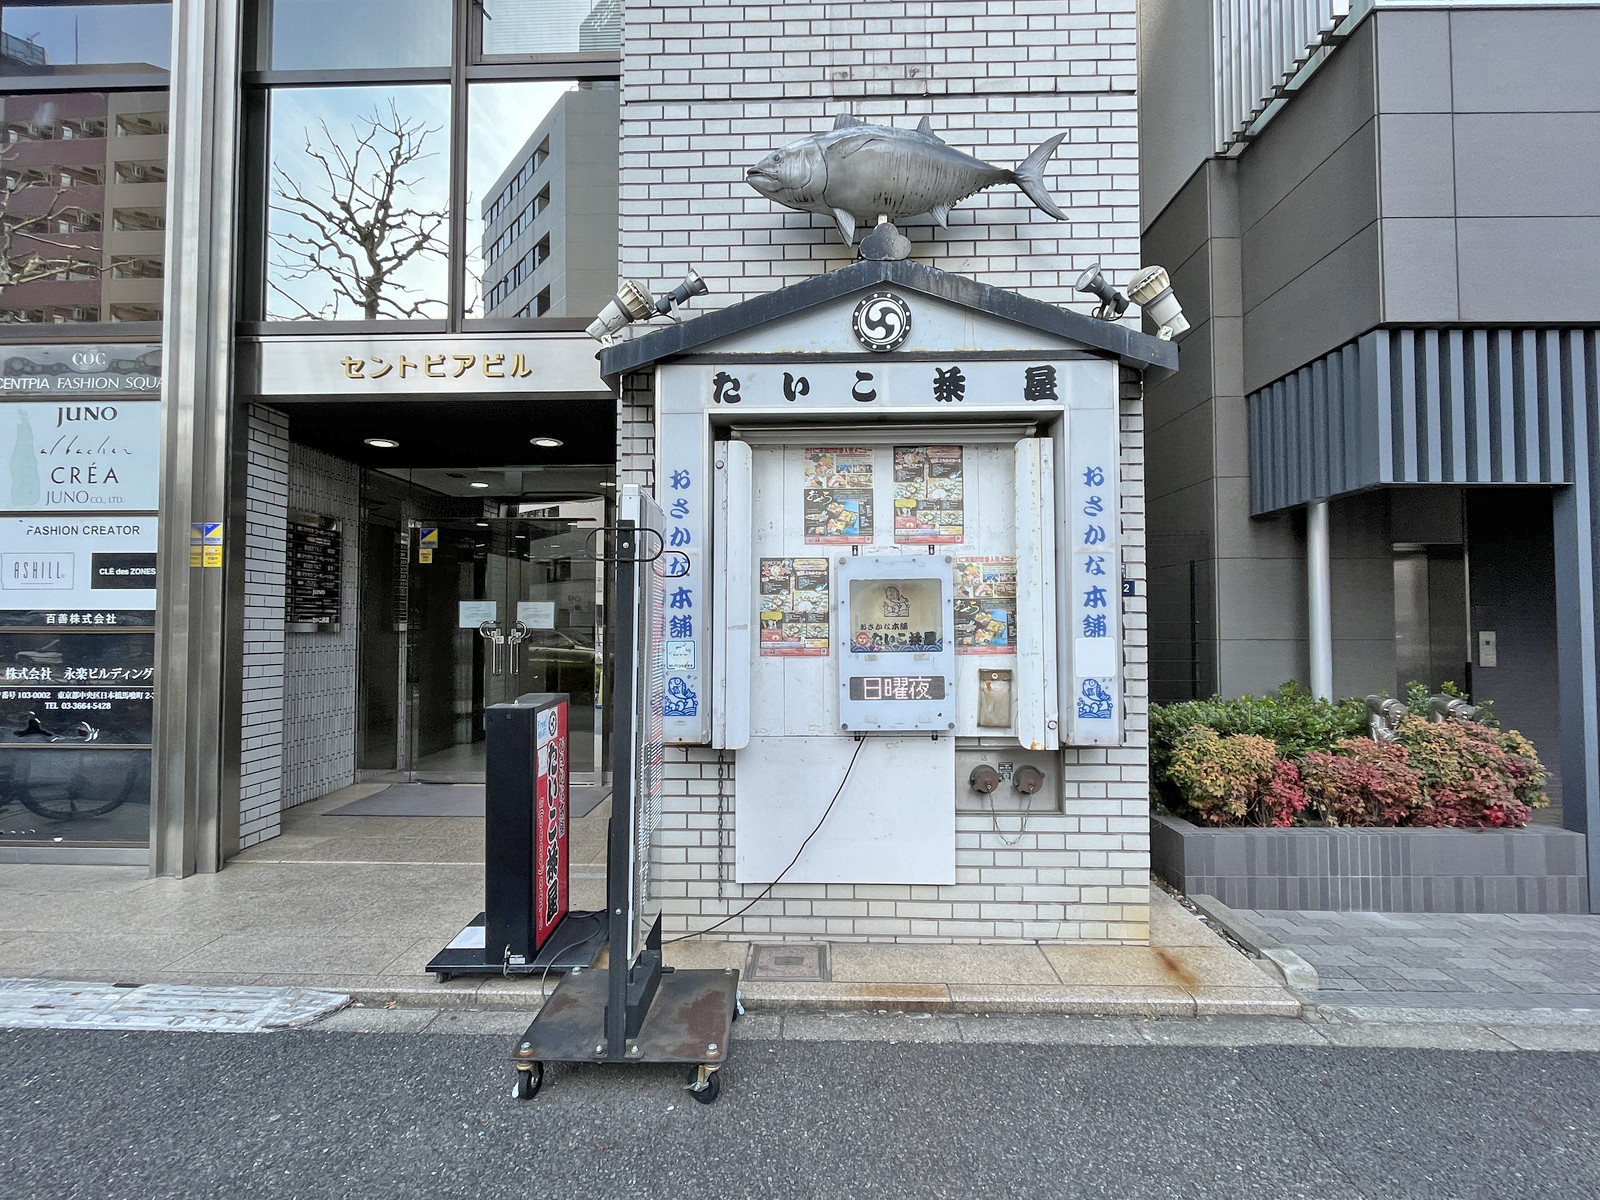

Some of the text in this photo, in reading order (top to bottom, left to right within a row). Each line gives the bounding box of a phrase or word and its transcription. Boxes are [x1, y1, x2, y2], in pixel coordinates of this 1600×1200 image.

[340, 353, 533, 379] セントピアビル
[57, 377, 120, 390] FASHION
[713, 364, 1059, 404] たいこ茶屋
[56, 406, 118, 428] JUNO
[51, 462, 119, 485] CRÉA
[45, 490, 89, 506] JUNO
[82, 525, 140, 536] CREATOR
[669, 469, 693, 638] おさかな本舗
[1083, 466, 1107, 638] おさかな本舗
[130, 567, 156, 575] ZONES
[1123, 583, 1130, 593] 2
[46, 613, 117, 625] 百善株式会社
[872, 631, 937, 646] たいこ茶屋
[5, 667, 154, 680] 株式会社 永楽ビルディング
[0, 691, 16, 700] 番号
[18, 691, 51, 699] 103-0002
[864, 676, 932, 700] 日曜夜
[45, 702, 111, 710] TEL 03-3664-5428
[546, 740, 559, 926] たいこ茶屋
